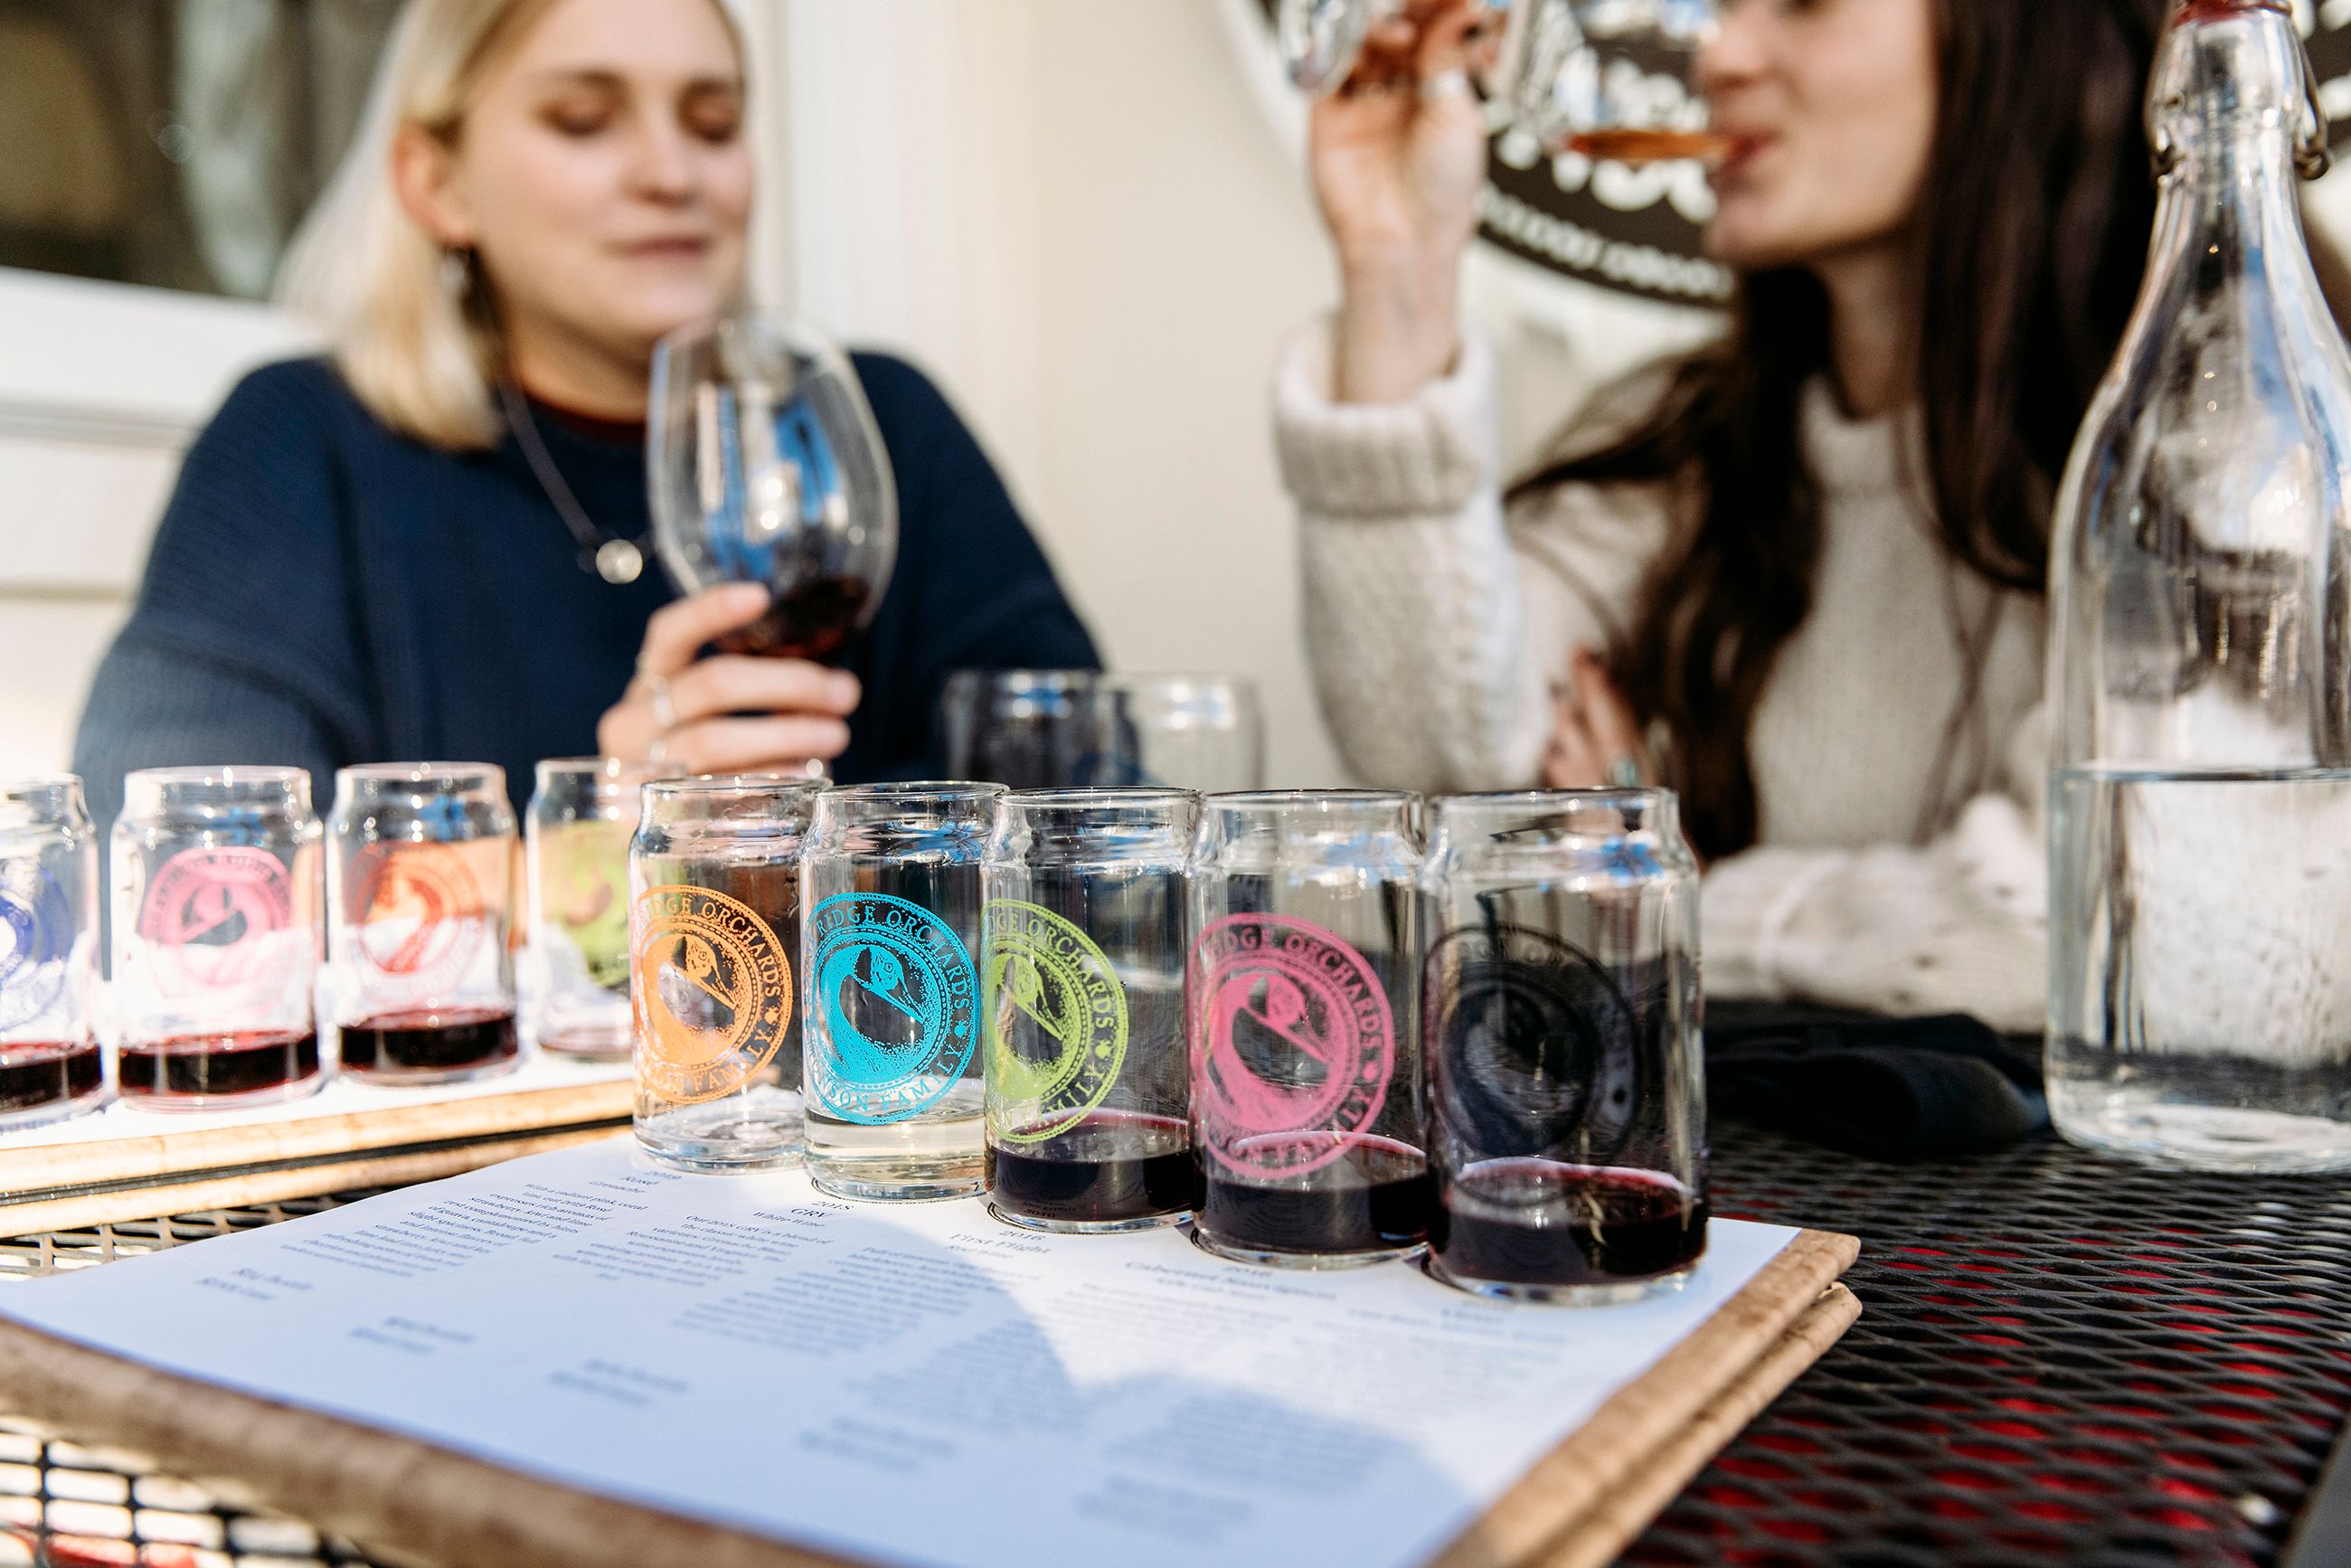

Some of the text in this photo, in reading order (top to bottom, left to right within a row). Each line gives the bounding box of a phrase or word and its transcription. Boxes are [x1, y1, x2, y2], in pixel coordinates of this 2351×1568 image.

[700, 902, 781, 998] ORCHARDS
[816, 905, 971, 1010] RIDGE ORCHARDS
[1028, 918, 1114, 1030] ORCHARDS
[1283, 932, 1383, 1050] ORCHARDS
[694, 1027, 774, 1092] FAMILY
[810, 1040, 964, 1112] ONSON FAMILY
[1024, 1064, 1106, 1130] FAMILY
[685, 1215, 710, 1224] Our
[752, 1211, 826, 1228] White Wine
[789, 1208, 834, 1219] GRV
[811, 1200, 854, 1212] 2018
[997, 1229, 1044, 1241] 2016
[949, 1233, 1052, 1255] First Flight
